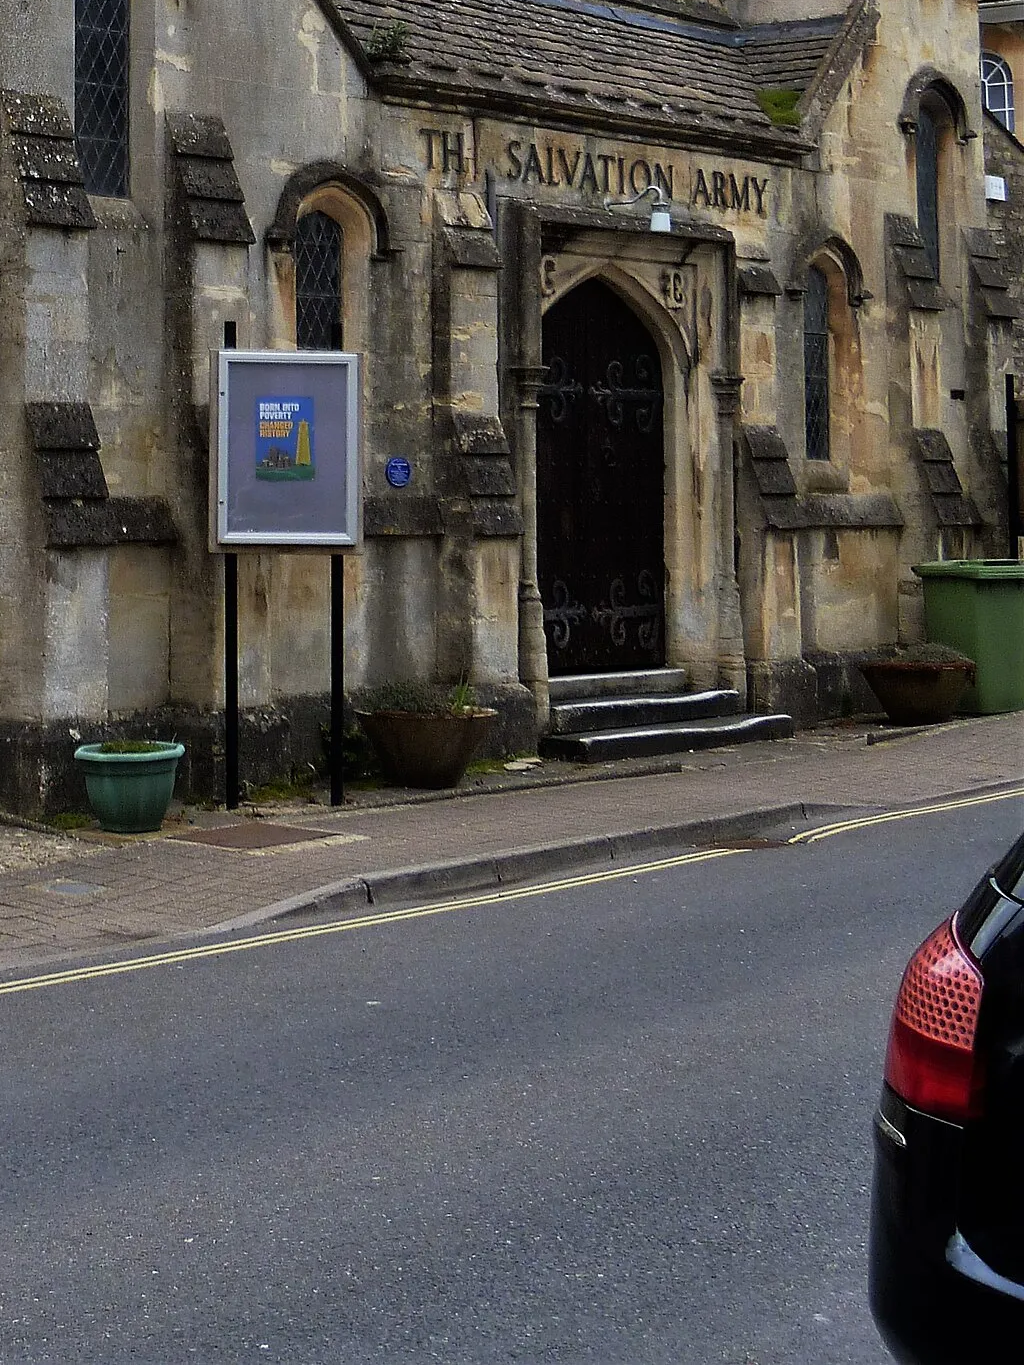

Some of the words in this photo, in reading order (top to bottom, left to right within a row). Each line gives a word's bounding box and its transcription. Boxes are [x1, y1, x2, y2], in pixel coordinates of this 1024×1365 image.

[506, 140, 675, 200] SALVATION
[693, 168, 770, 218] ARMY
[259, 403, 280, 411] BORN
[282, 403, 300, 411] INTO
[259, 412, 292, 420] POVERTY
[259, 421, 293, 430] CHANGED
[259, 430, 290, 438] HISTORY
